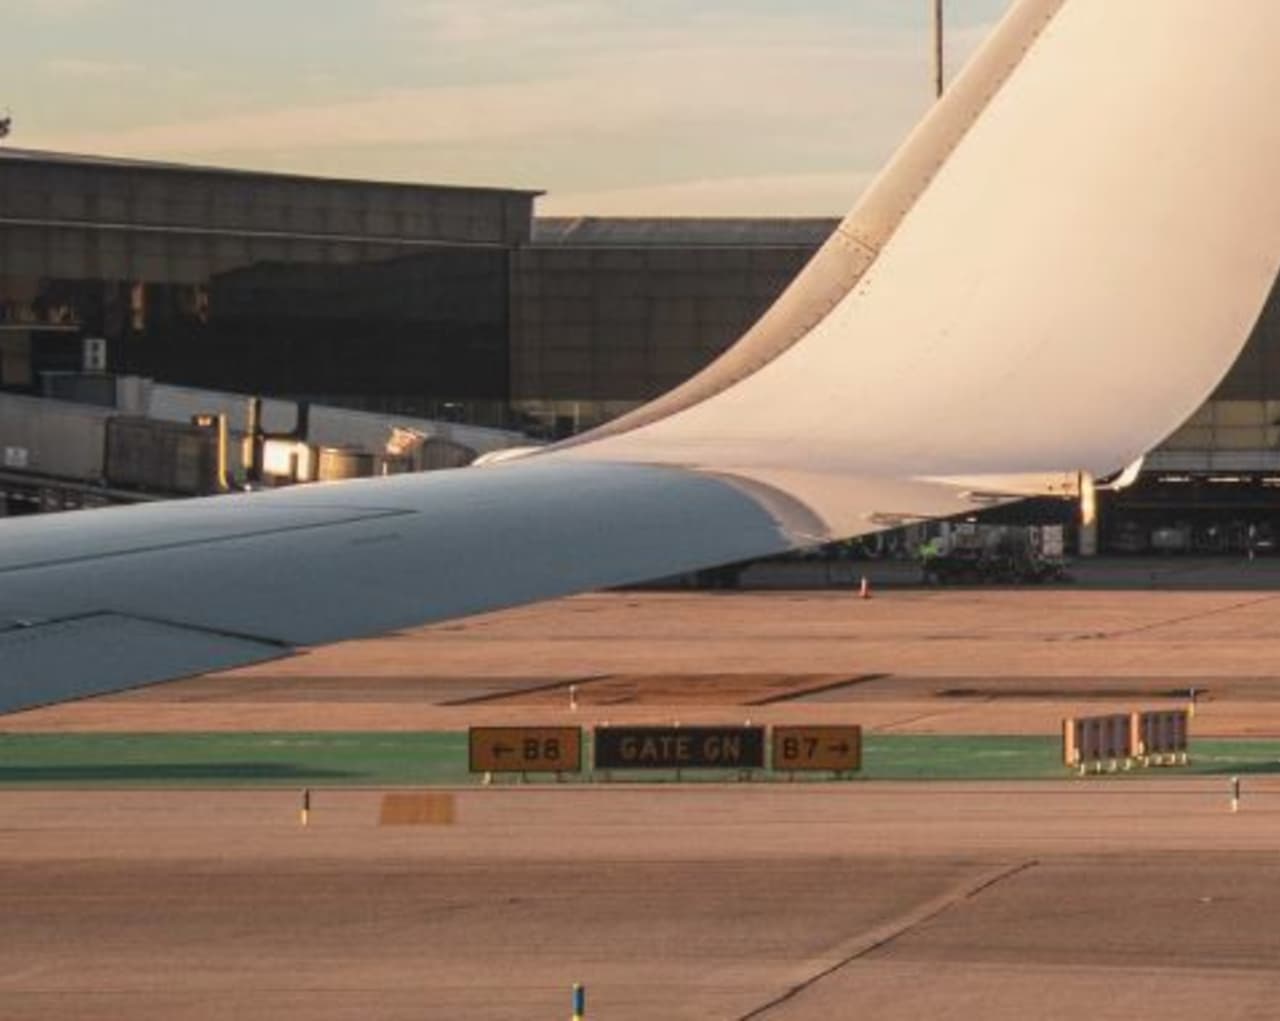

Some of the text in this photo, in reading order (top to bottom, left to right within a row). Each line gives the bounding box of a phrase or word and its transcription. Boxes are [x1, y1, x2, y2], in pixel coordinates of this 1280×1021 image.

[621, 736, 740, 760] GATE GN
[783, 737, 818, 760] B7
